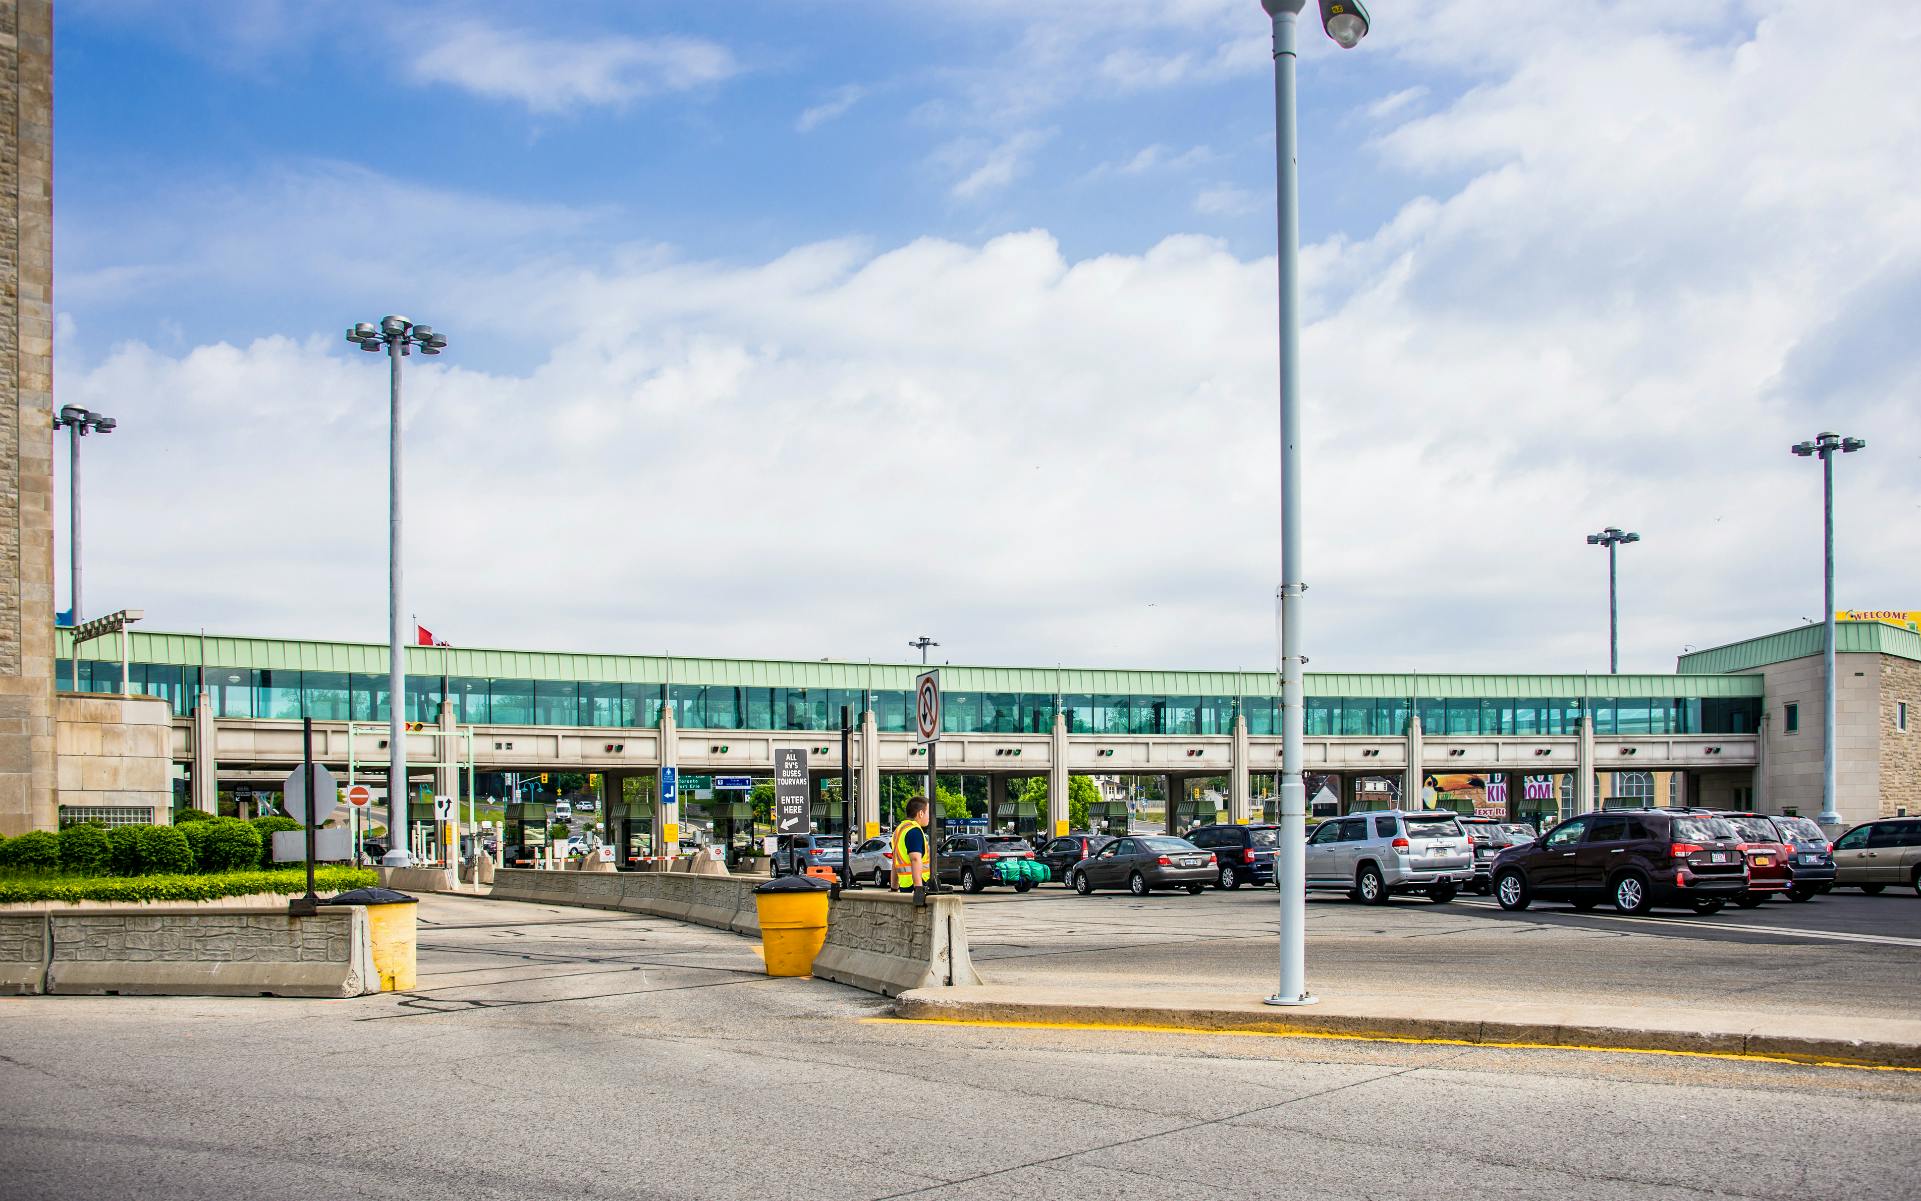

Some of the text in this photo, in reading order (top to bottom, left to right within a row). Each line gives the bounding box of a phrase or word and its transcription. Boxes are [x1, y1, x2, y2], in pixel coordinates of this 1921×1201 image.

[1854, 611, 1907, 620] WELCOME
[786, 753, 797, 761] ALL
[782, 770, 802, 778] BUSES
[777, 778, 808, 786] TOURVANS
[781, 795, 804, 804] ENTER
[783, 805, 803, 814] HERE
